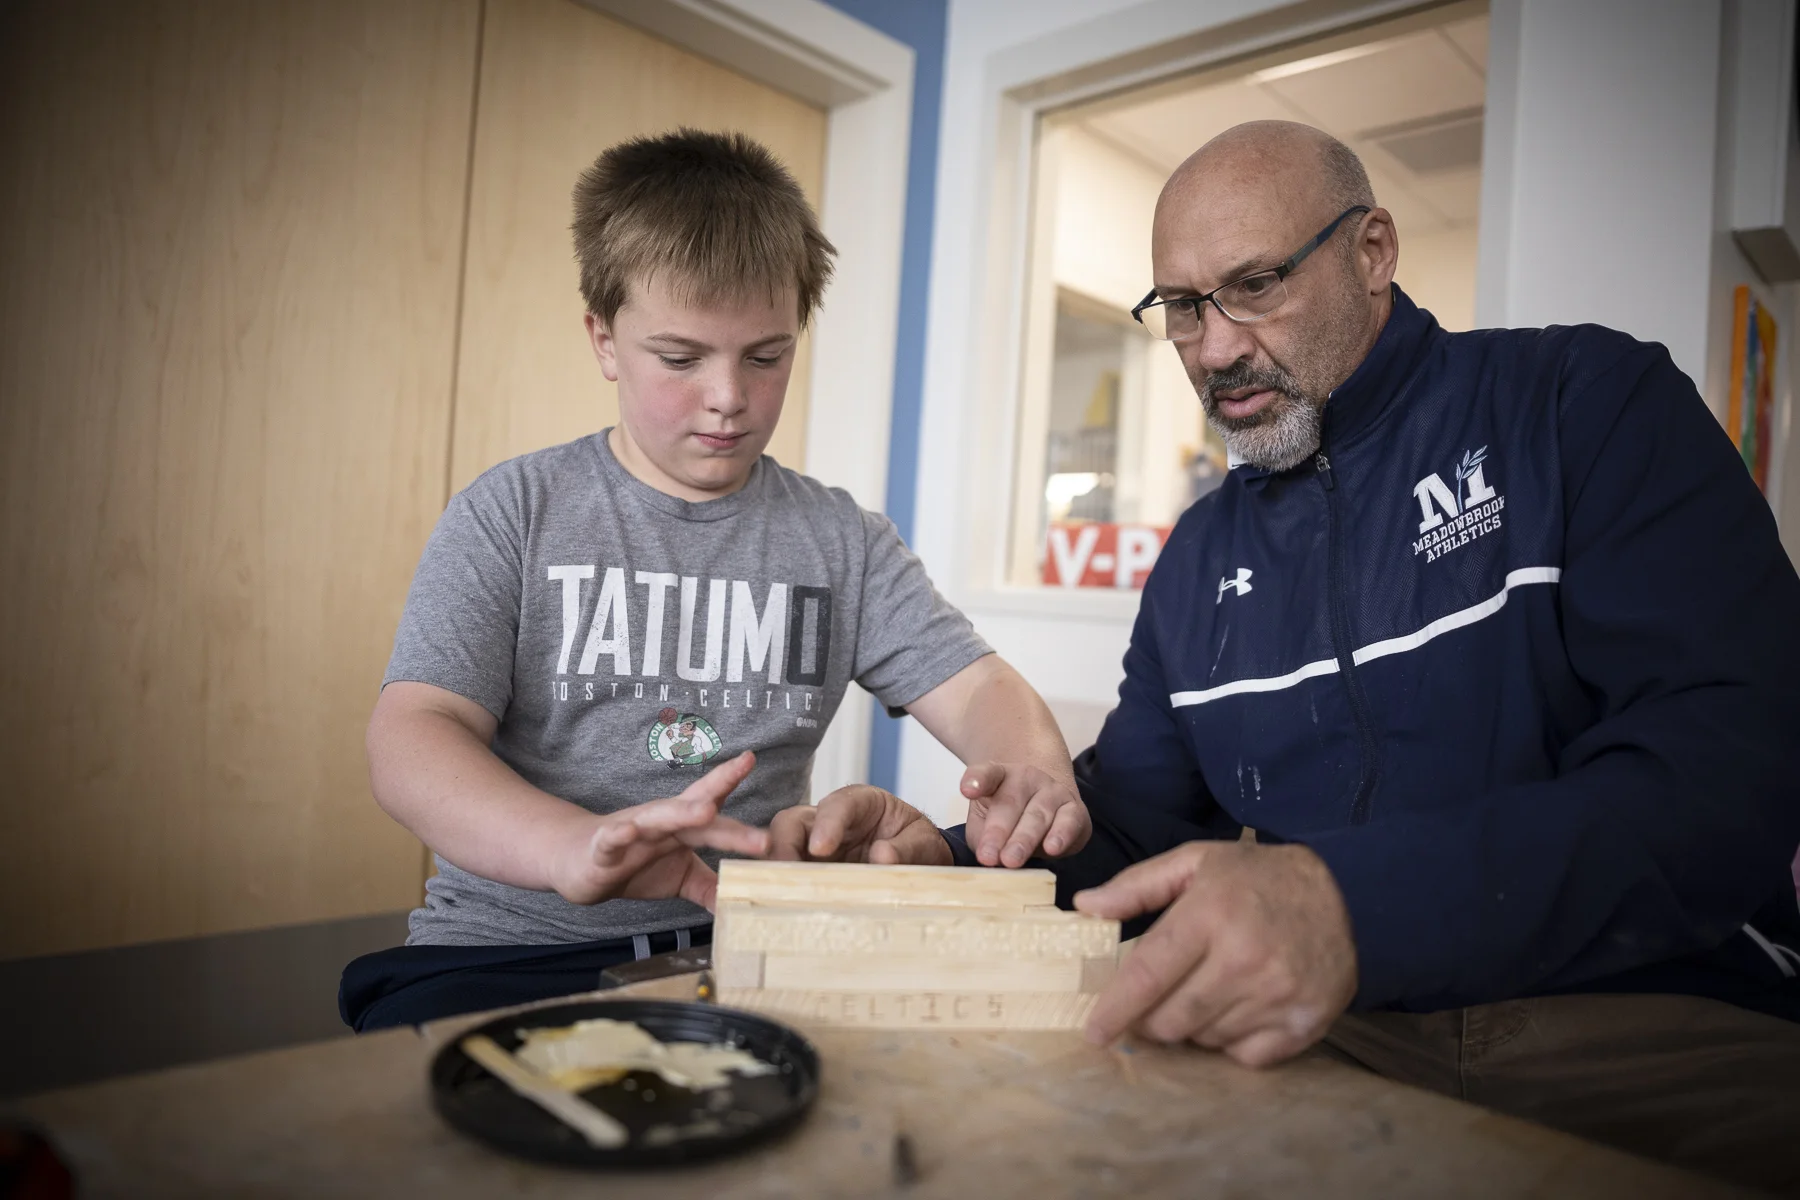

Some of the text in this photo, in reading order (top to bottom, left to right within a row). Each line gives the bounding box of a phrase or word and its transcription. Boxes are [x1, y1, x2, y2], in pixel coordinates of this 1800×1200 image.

[1426, 514, 1502, 563] ATHLETICS
[548, 565, 788, 685] TATUM
[553, 682, 823, 712] OSTON CELTIC
[816, 993, 1004, 1022] CELTICS
